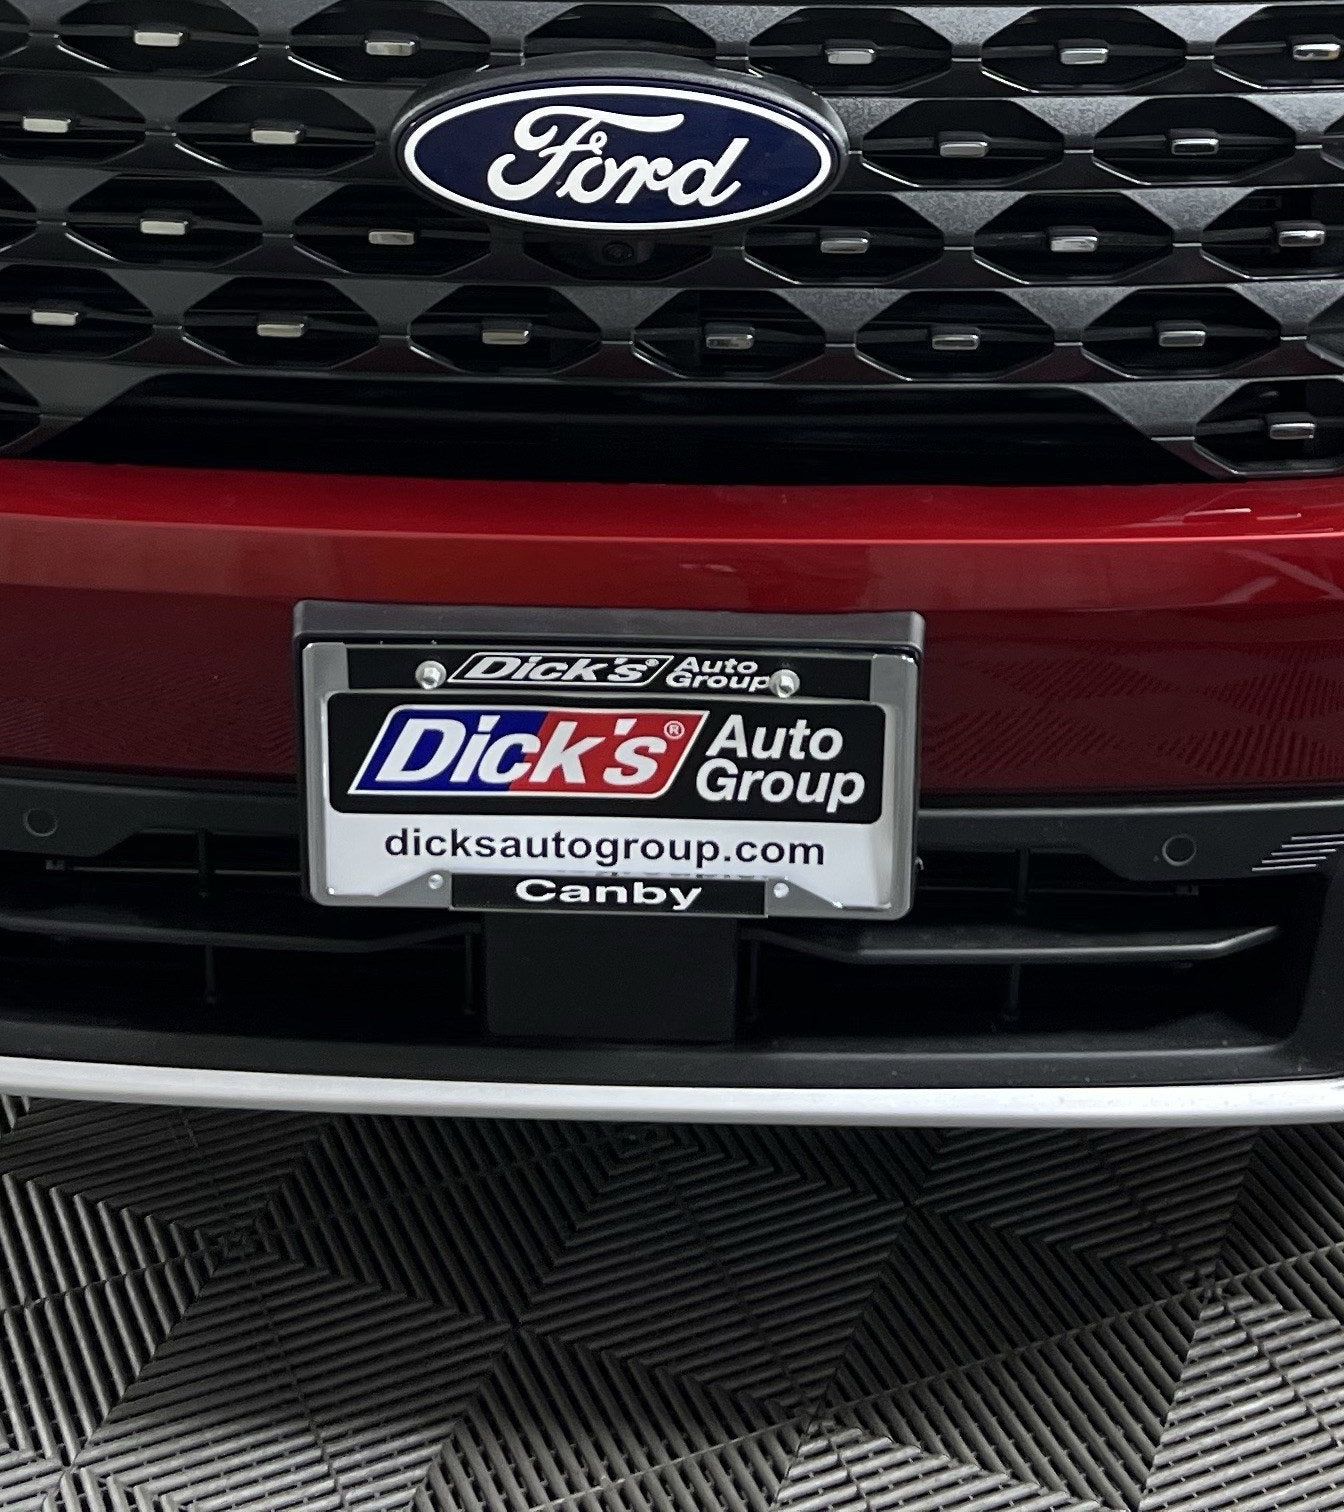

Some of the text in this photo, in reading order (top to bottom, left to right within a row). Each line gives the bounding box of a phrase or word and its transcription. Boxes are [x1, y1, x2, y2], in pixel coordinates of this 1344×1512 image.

[487, 105, 750, 207] Ford
[666, 671, 771, 693] Group
[673, 656, 759, 675] Auto
[706, 714, 844, 761] Auto
[696, 758, 866, 813] Group
[384, 827, 826, 868] dicksautogroup.com
[515, 878, 703, 910] Canby
